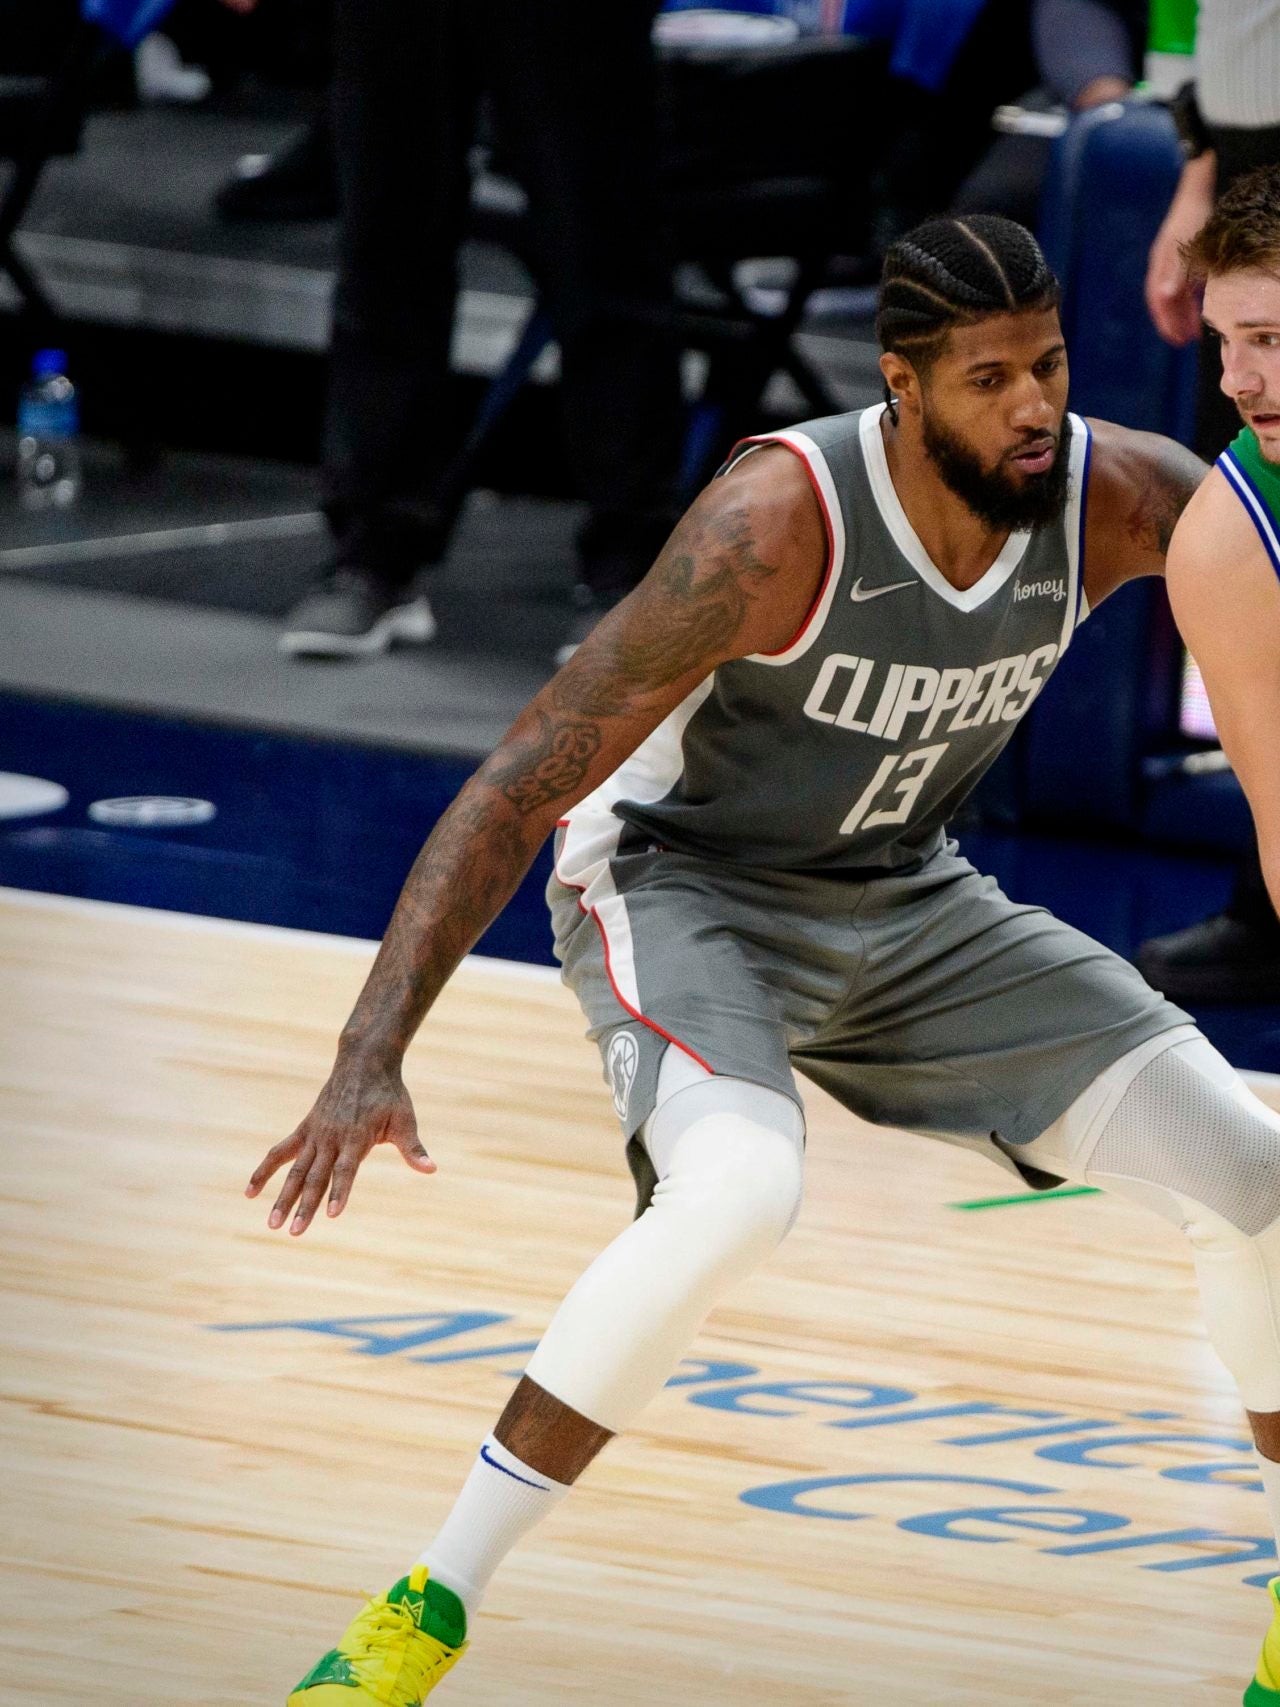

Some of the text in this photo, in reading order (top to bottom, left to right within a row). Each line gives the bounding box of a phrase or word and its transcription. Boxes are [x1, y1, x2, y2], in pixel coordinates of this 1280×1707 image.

[1013, 578, 1067, 603] honey
[803, 642, 1059, 741] CLIPPERS
[839, 743, 950, 835] 13
